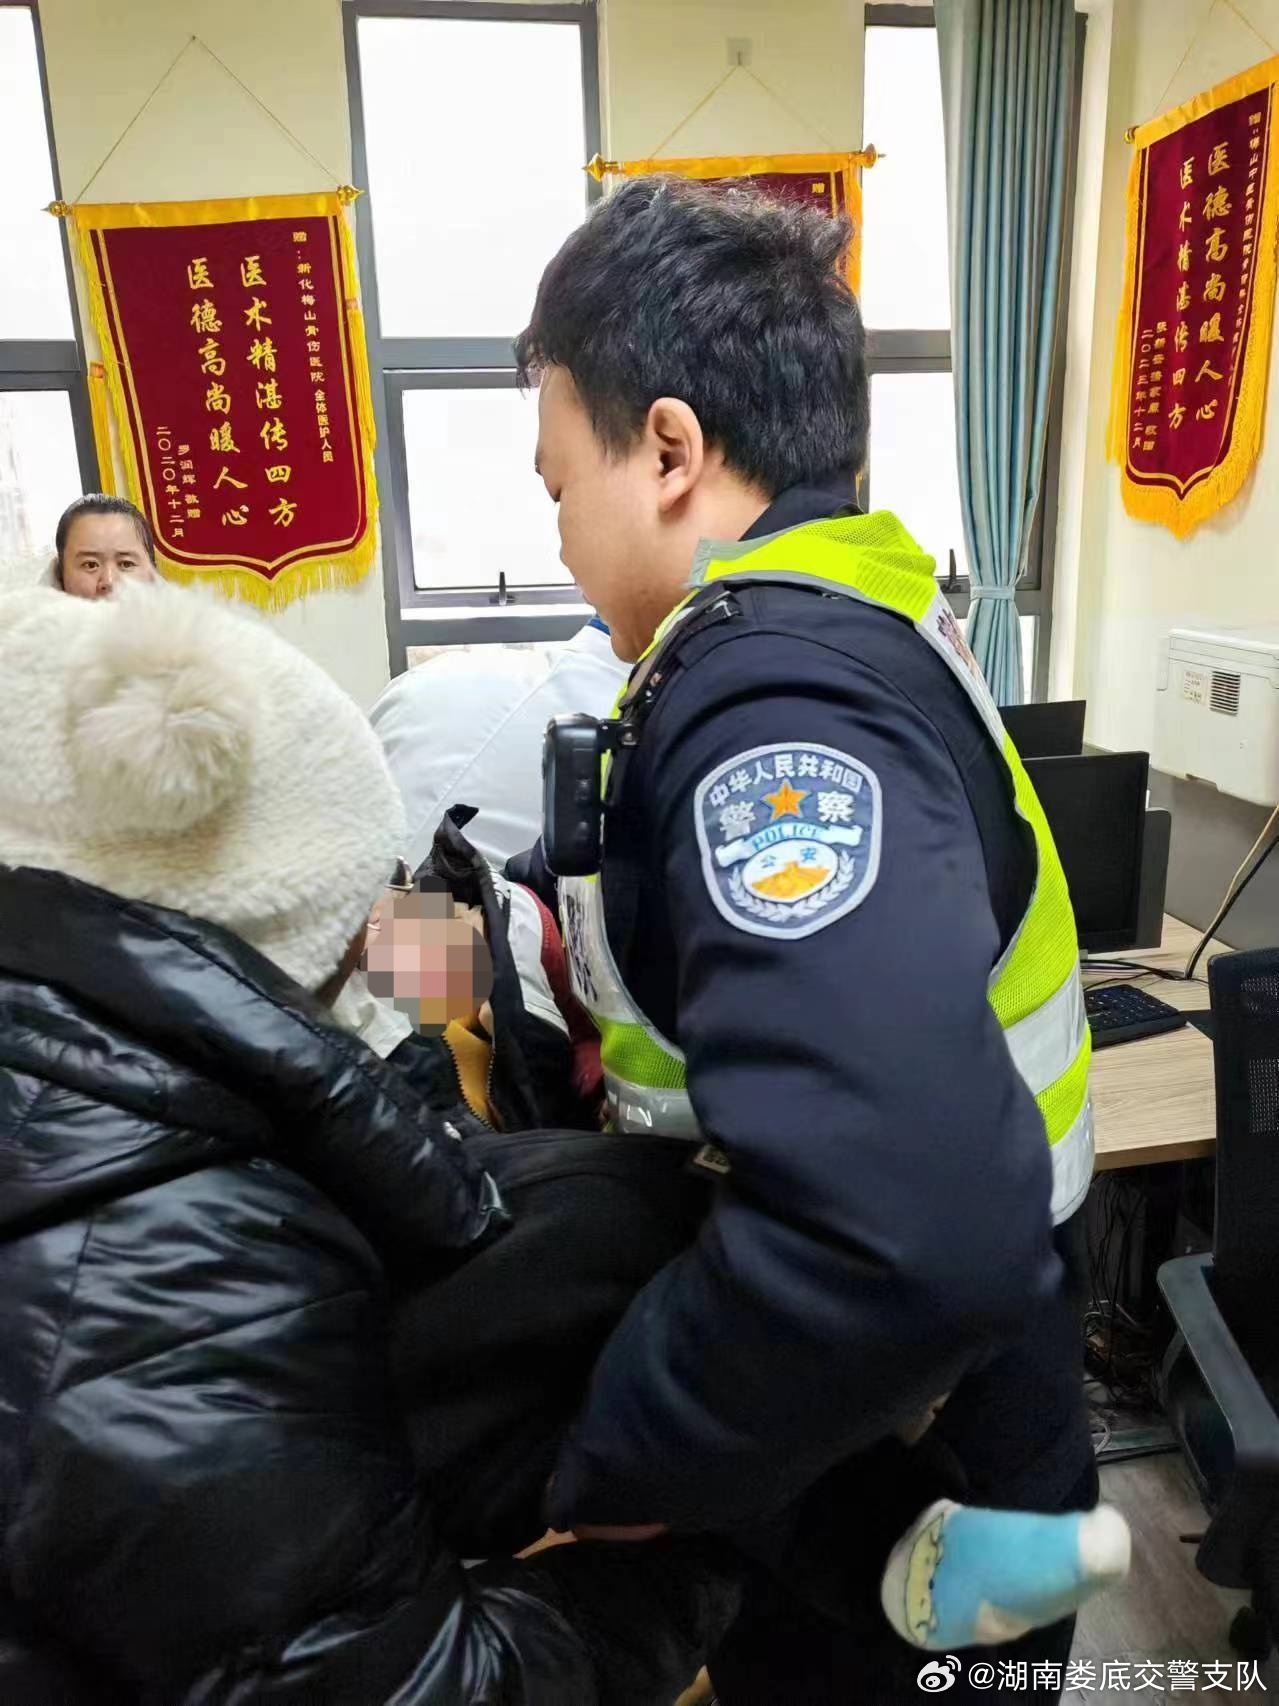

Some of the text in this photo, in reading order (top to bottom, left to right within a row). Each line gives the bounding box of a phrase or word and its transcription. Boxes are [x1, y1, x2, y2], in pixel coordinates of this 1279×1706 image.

[187, 257, 249, 526] 医德高尚暖人心
[239, 255, 298, 527] 医术精湛传四方
[709, 753, 863, 807] 中华人民共和国
